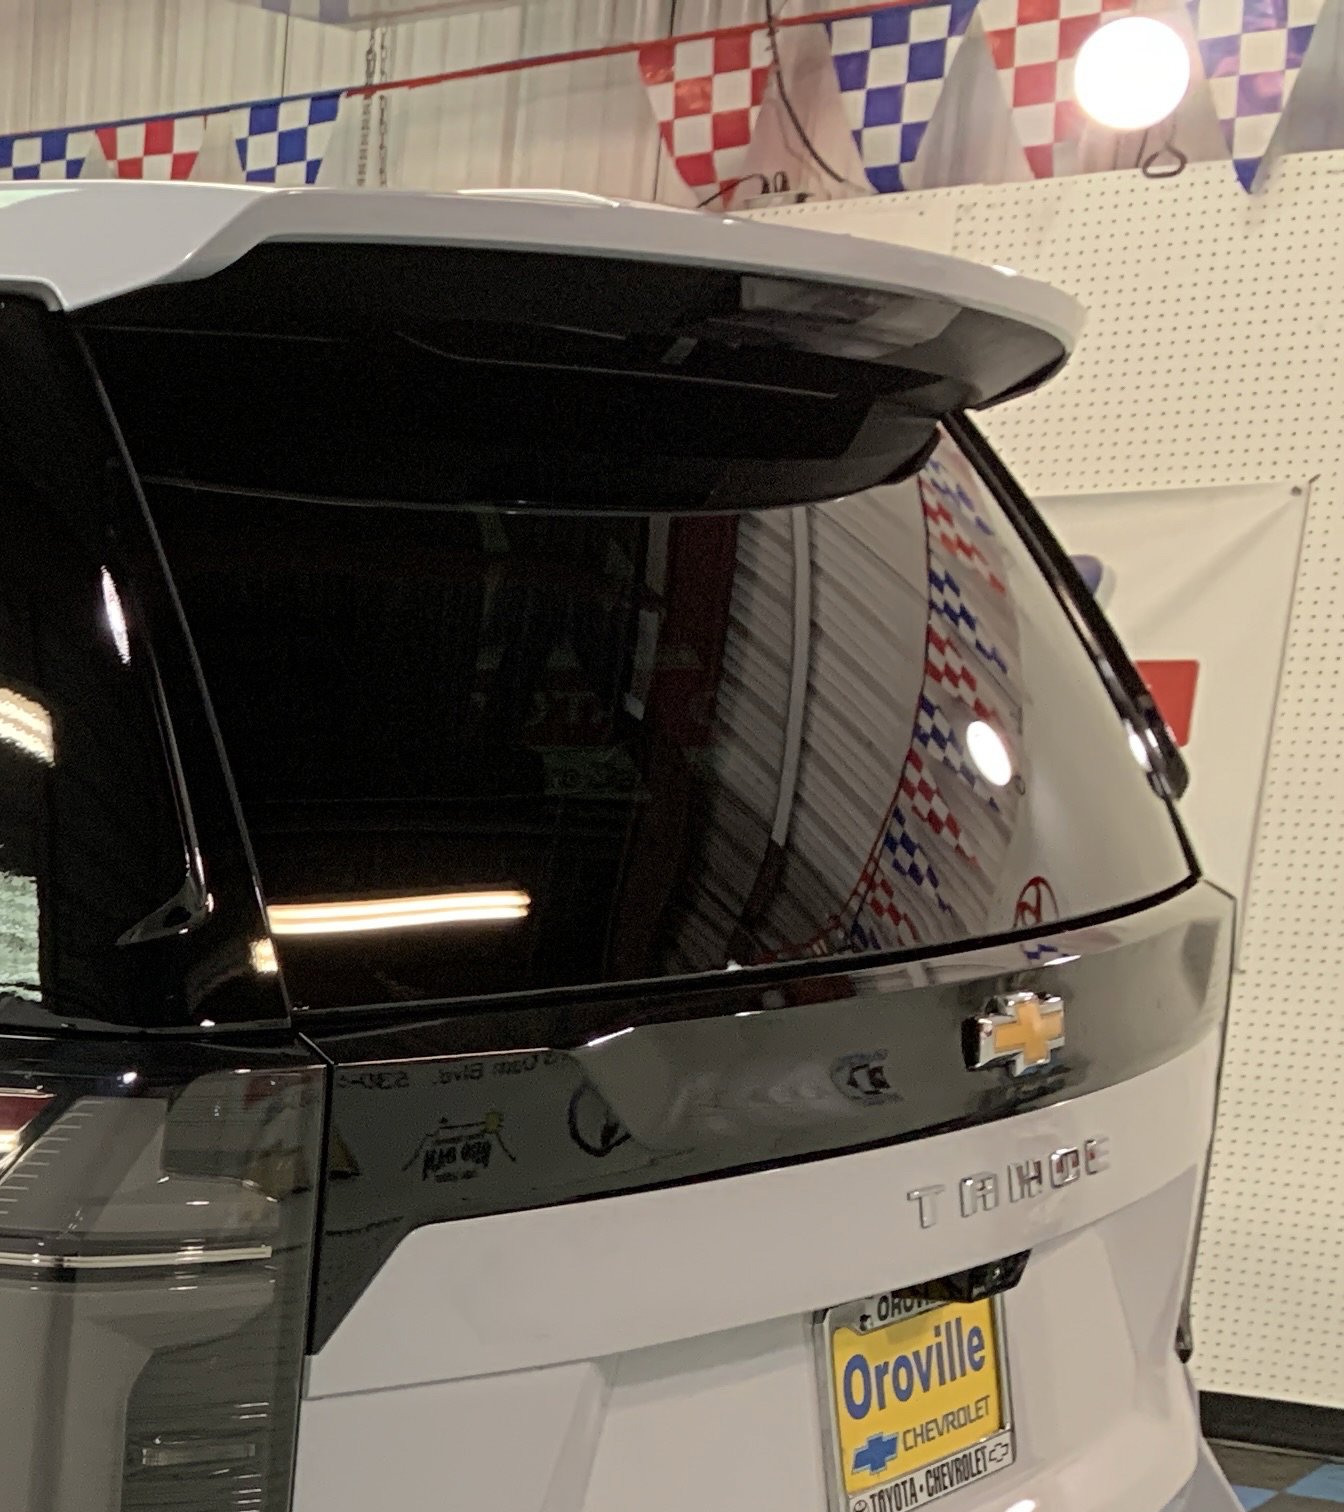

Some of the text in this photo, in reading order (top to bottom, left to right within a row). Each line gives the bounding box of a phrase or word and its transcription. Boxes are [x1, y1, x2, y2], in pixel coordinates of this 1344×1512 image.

[906, 1135, 1111, 1229] TAHOE
[843, 1316, 986, 1421] Oroville
[903, 1395, 991, 1452] CHEVROLET
[925, 1445, 988, 1498] CHEVROLET
